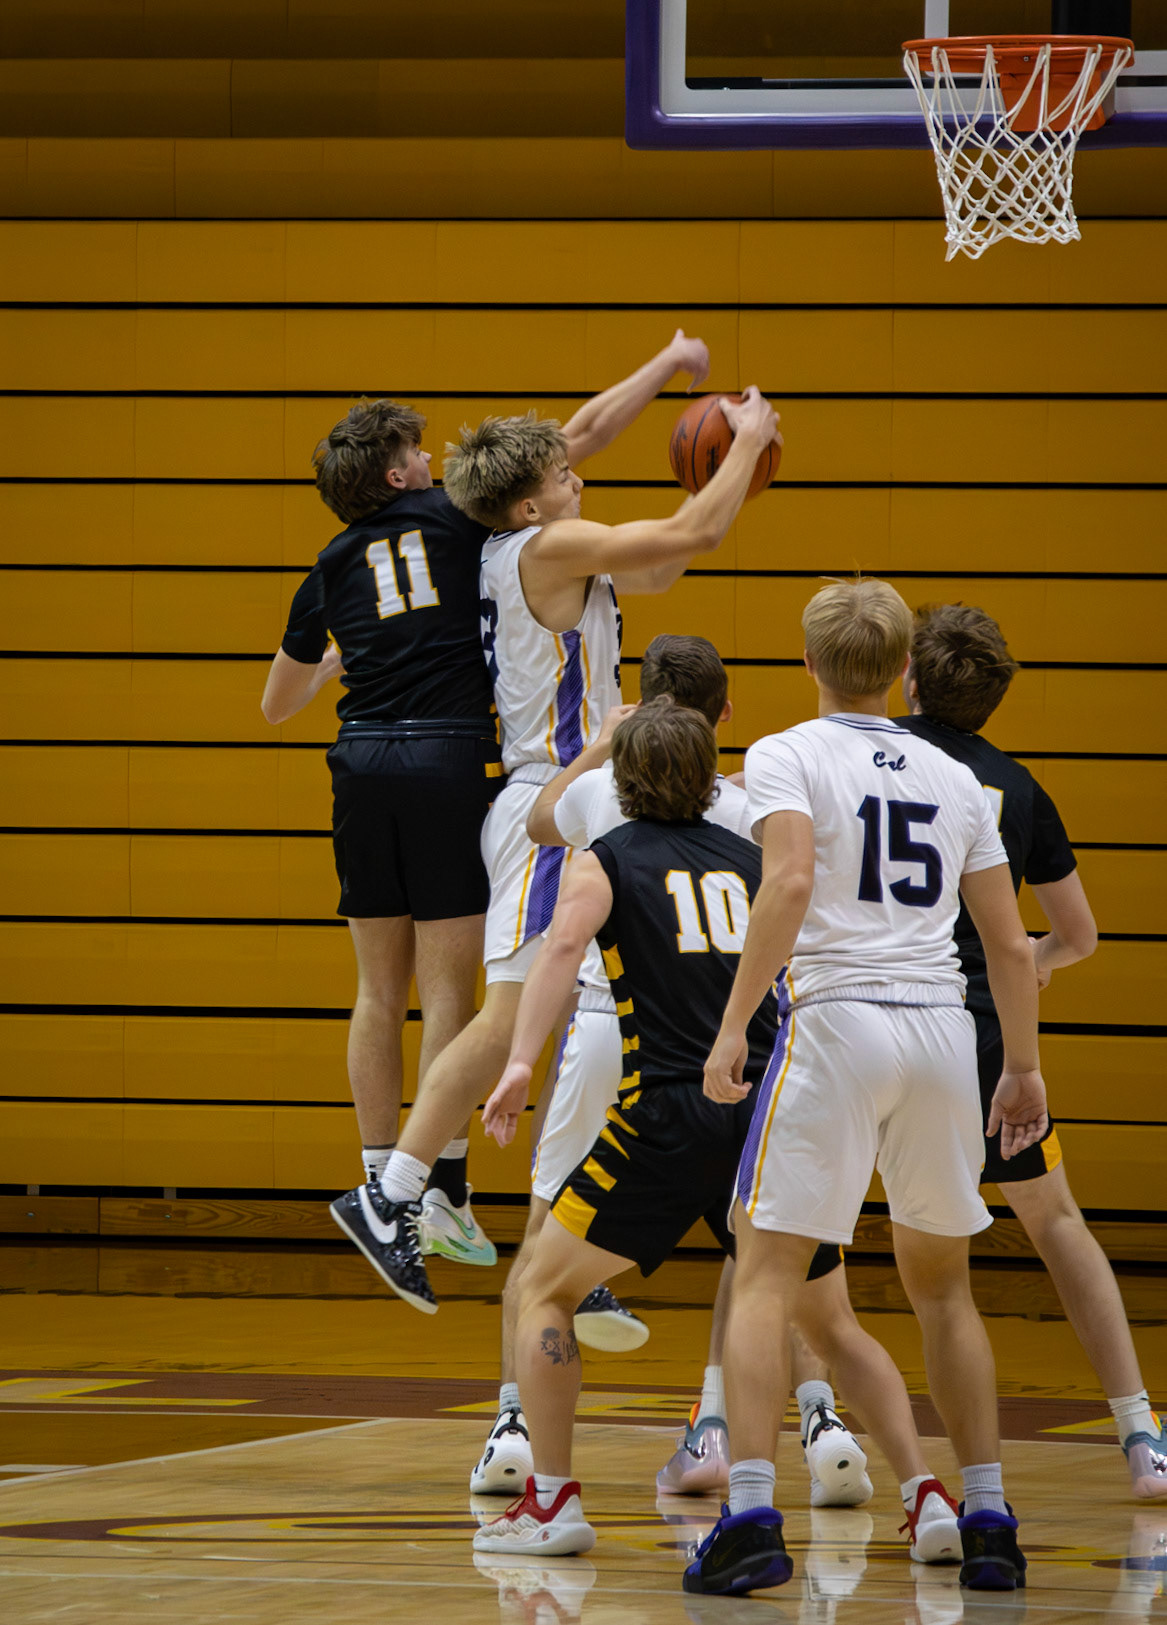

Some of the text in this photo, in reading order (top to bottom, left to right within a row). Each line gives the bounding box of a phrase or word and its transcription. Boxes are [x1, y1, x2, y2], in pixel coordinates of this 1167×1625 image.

[365, 529, 440, 620] 11
[856, 794, 943, 908] 15
[665, 869, 751, 954] 10
